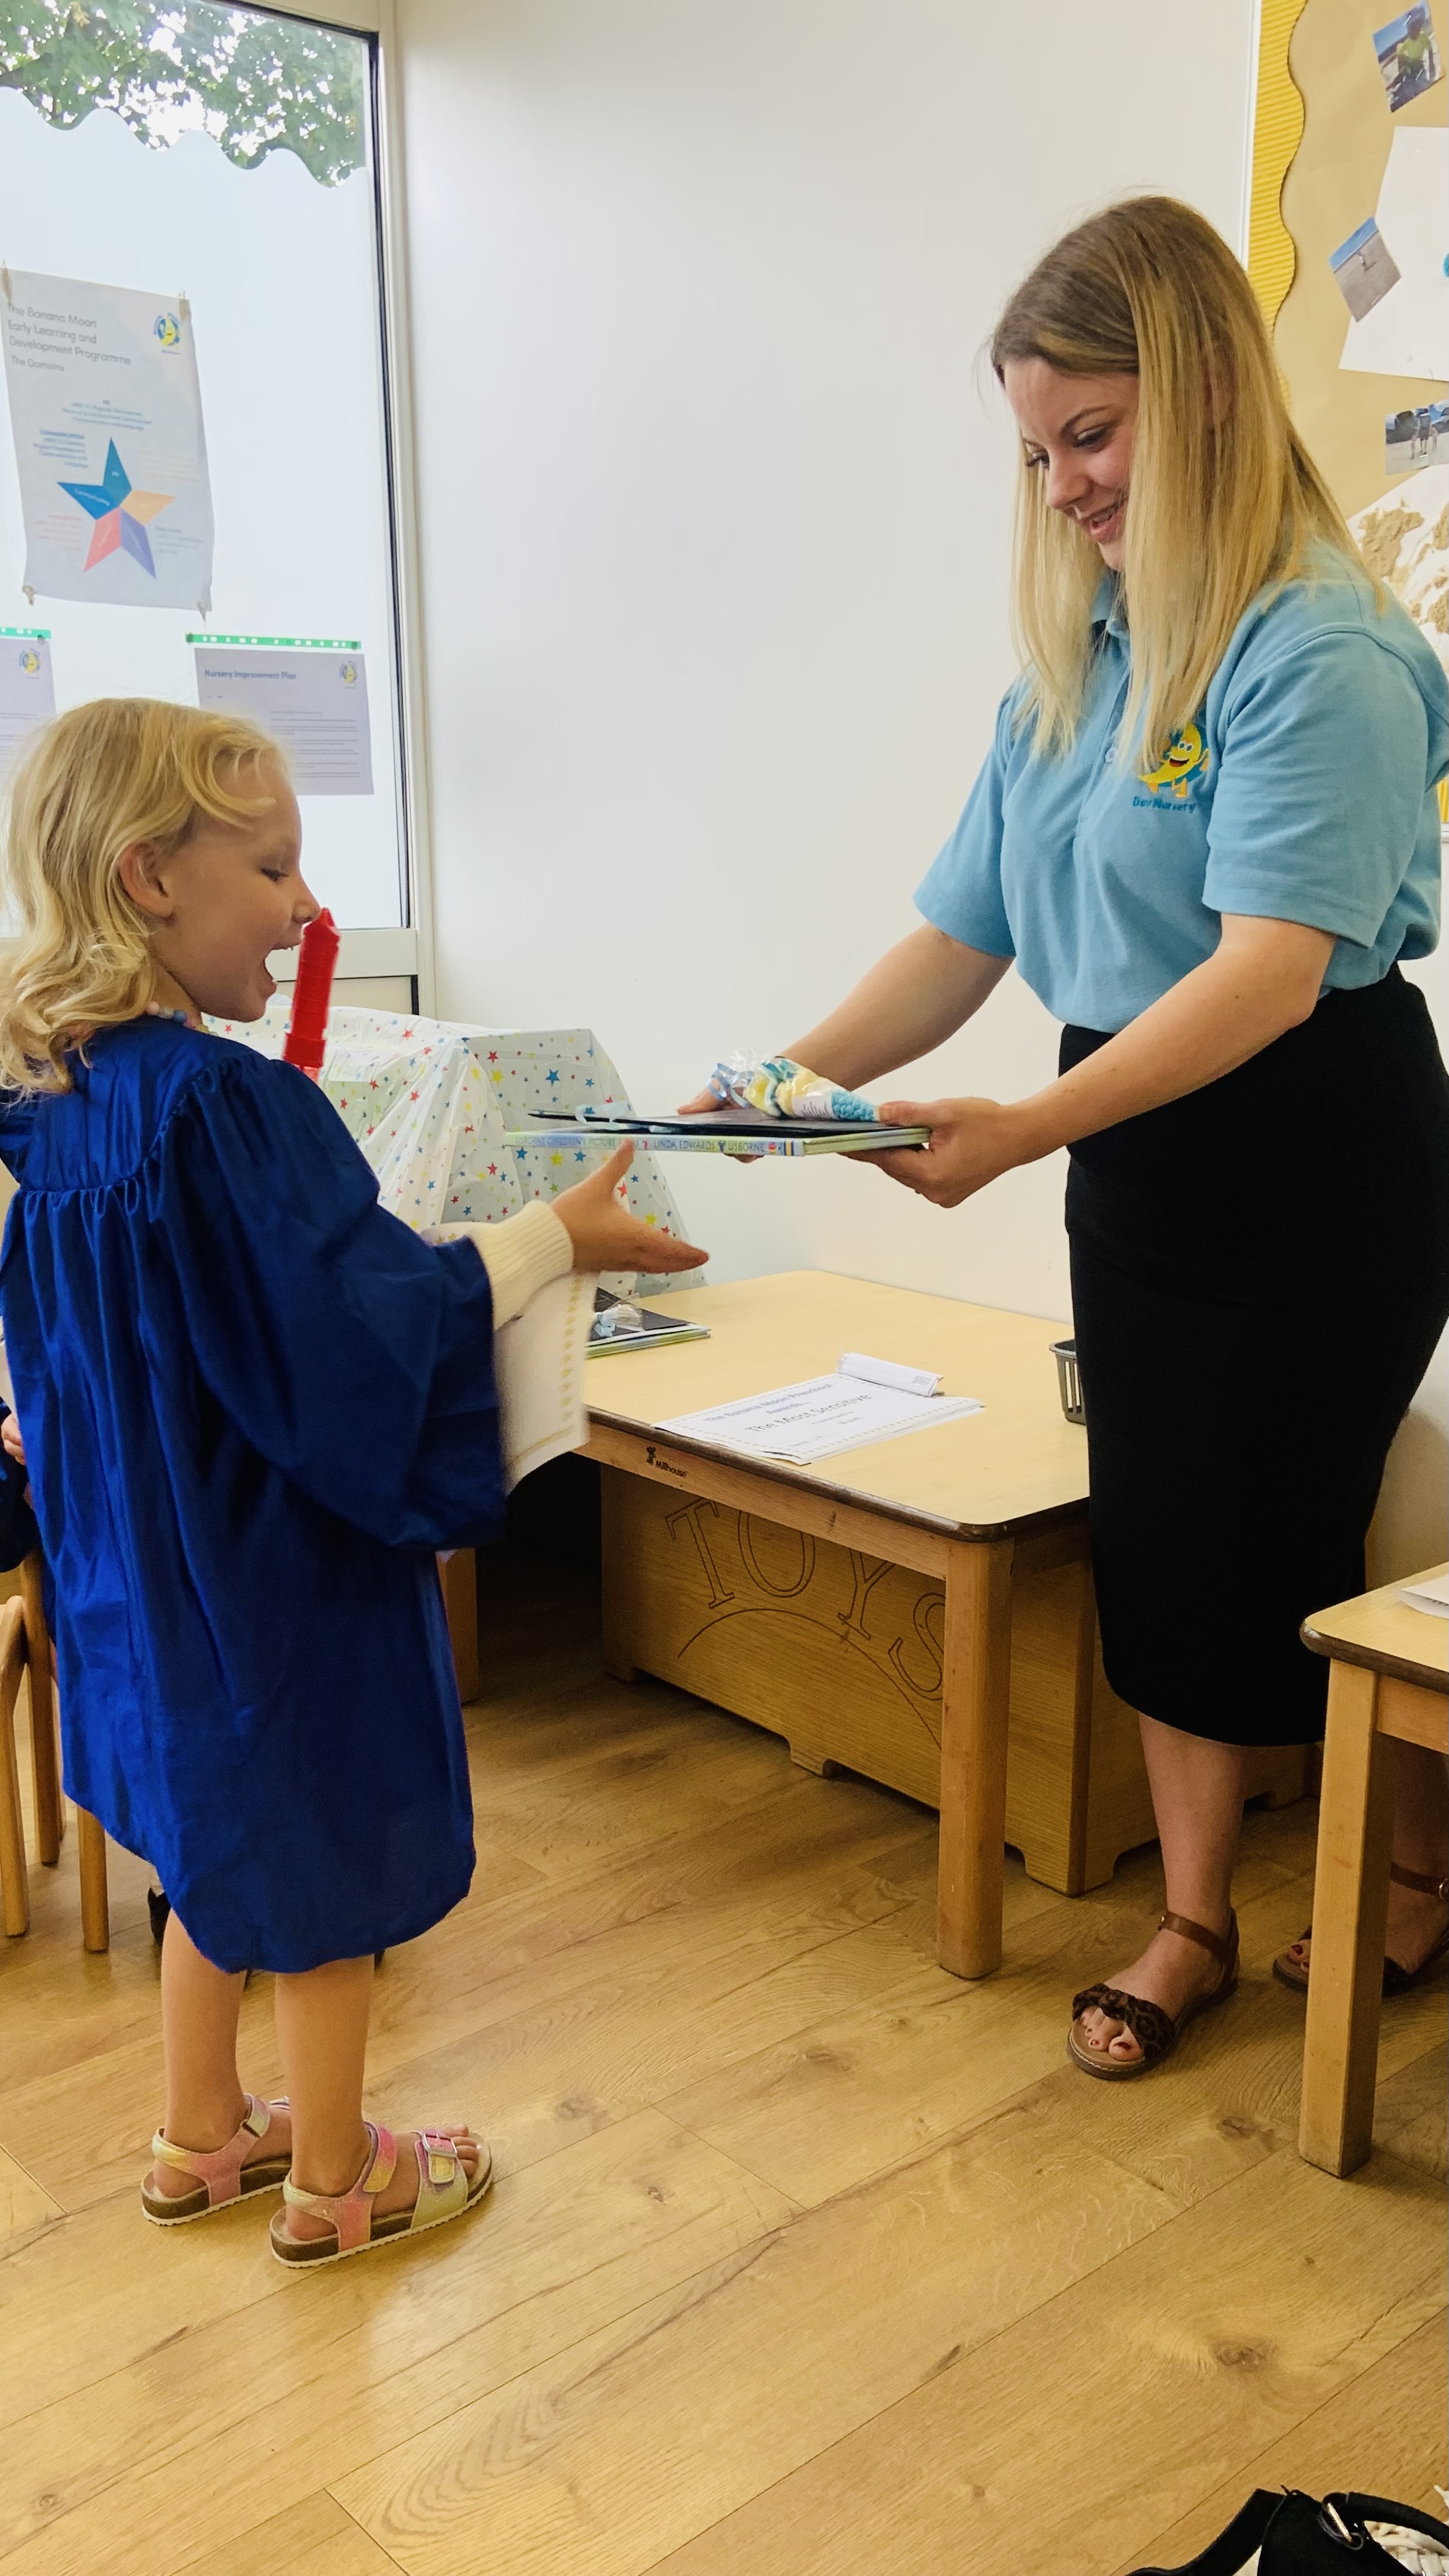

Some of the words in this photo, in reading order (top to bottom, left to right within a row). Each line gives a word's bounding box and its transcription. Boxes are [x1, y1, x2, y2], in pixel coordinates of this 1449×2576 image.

[8, 304, 24, 317] The
[27, 307, 65, 323] Banana
[68, 315, 97, 328] Moon
[9, 320, 31, 335] Early
[34, 324, 75, 343] Learning
[78, 333, 97, 344] and
[9, 335, 72, 355] Development
[75, 347, 131, 365] Programme
[11, 355, 25, 366] The
[27, 358, 65, 371] Domains
[204, 669, 233, 680] Nursery
[234, 670, 279, 680] Improvement
[1132, 795, 1152, 809] Day
[1152, 797, 1196, 814] Nursery
[654, 1139, 677, 1149] LINDA
[679, 1140, 715, 1150] EDWARDS
[728, 1142, 765, 1152] USBORNE
[723, 1405, 763, 1417] Banana
[759, 1397, 791, 1407] Moon
[787, 1384, 834, 1398] Preschool
[744, 1423, 779, 1432] The
[774, 1412, 816, 1424] Most
[810, 1394, 872, 1414] Sensitive
[655, 1460, 688, 1478] Millhouse
[665, 1497, 946, 1701] TOYS
